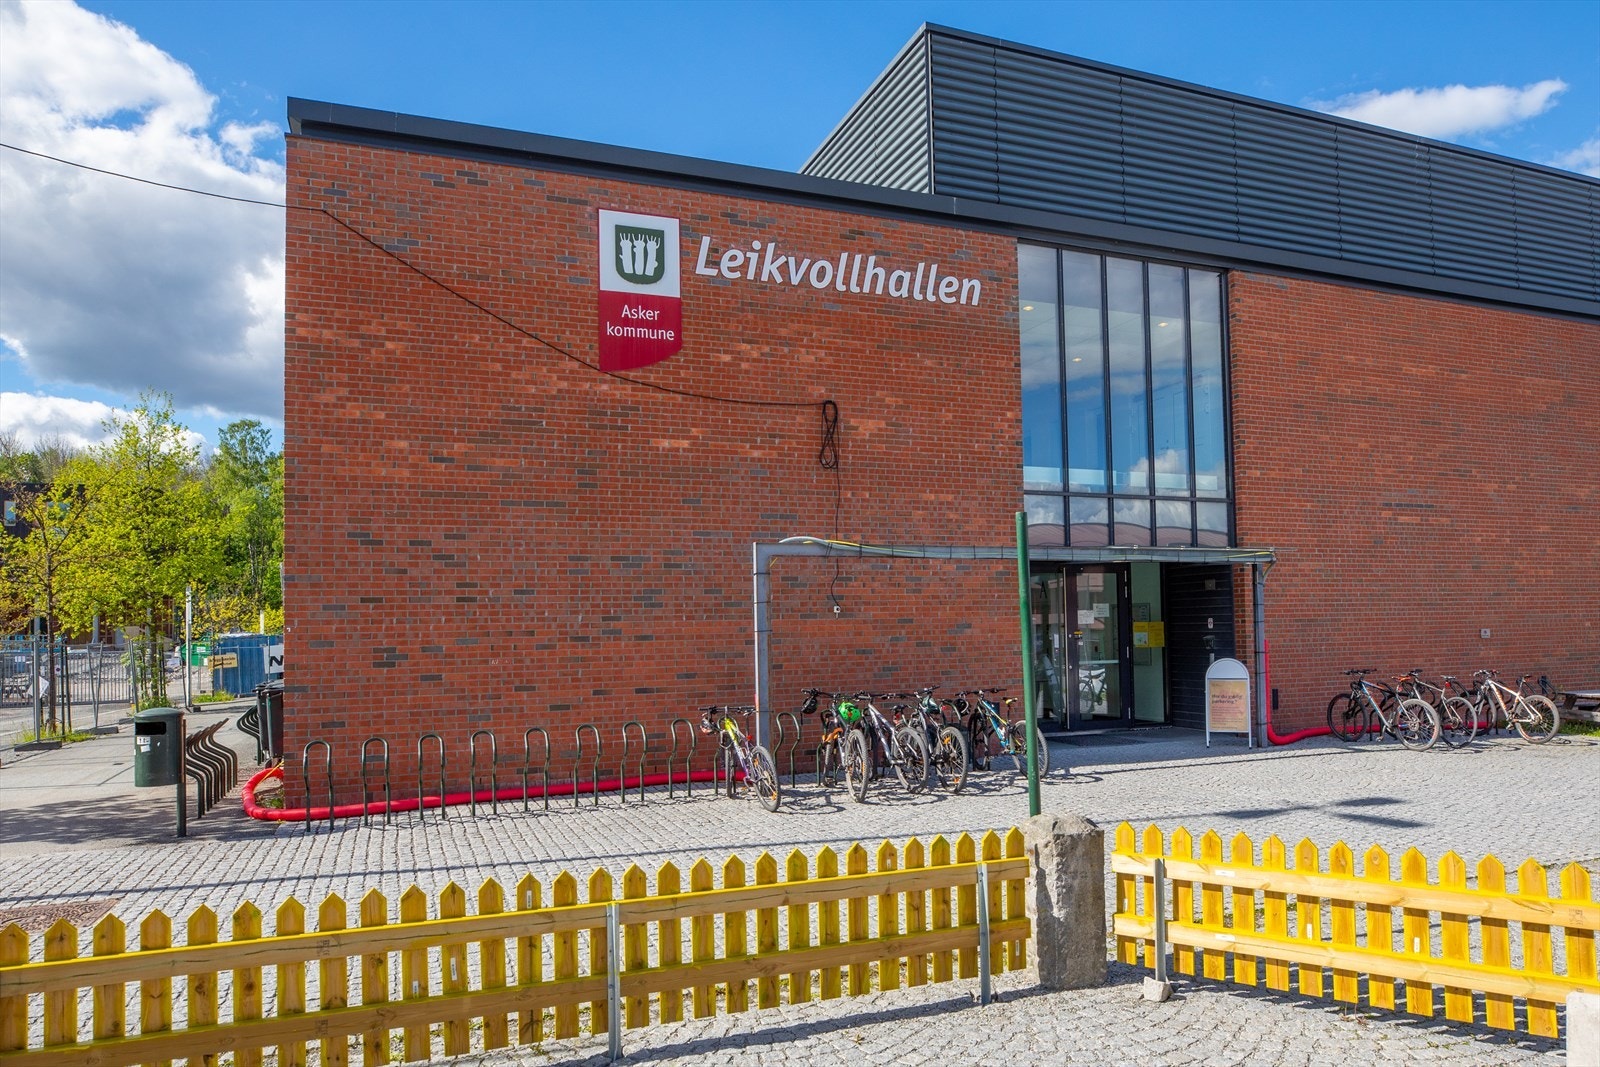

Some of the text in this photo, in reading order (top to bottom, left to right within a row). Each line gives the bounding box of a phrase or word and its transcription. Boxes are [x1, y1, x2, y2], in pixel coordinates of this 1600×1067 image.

[695, 236, 981, 306] Leikvollhallen
[621, 304, 660, 321] Asker
[606, 322, 675, 341] kommune
